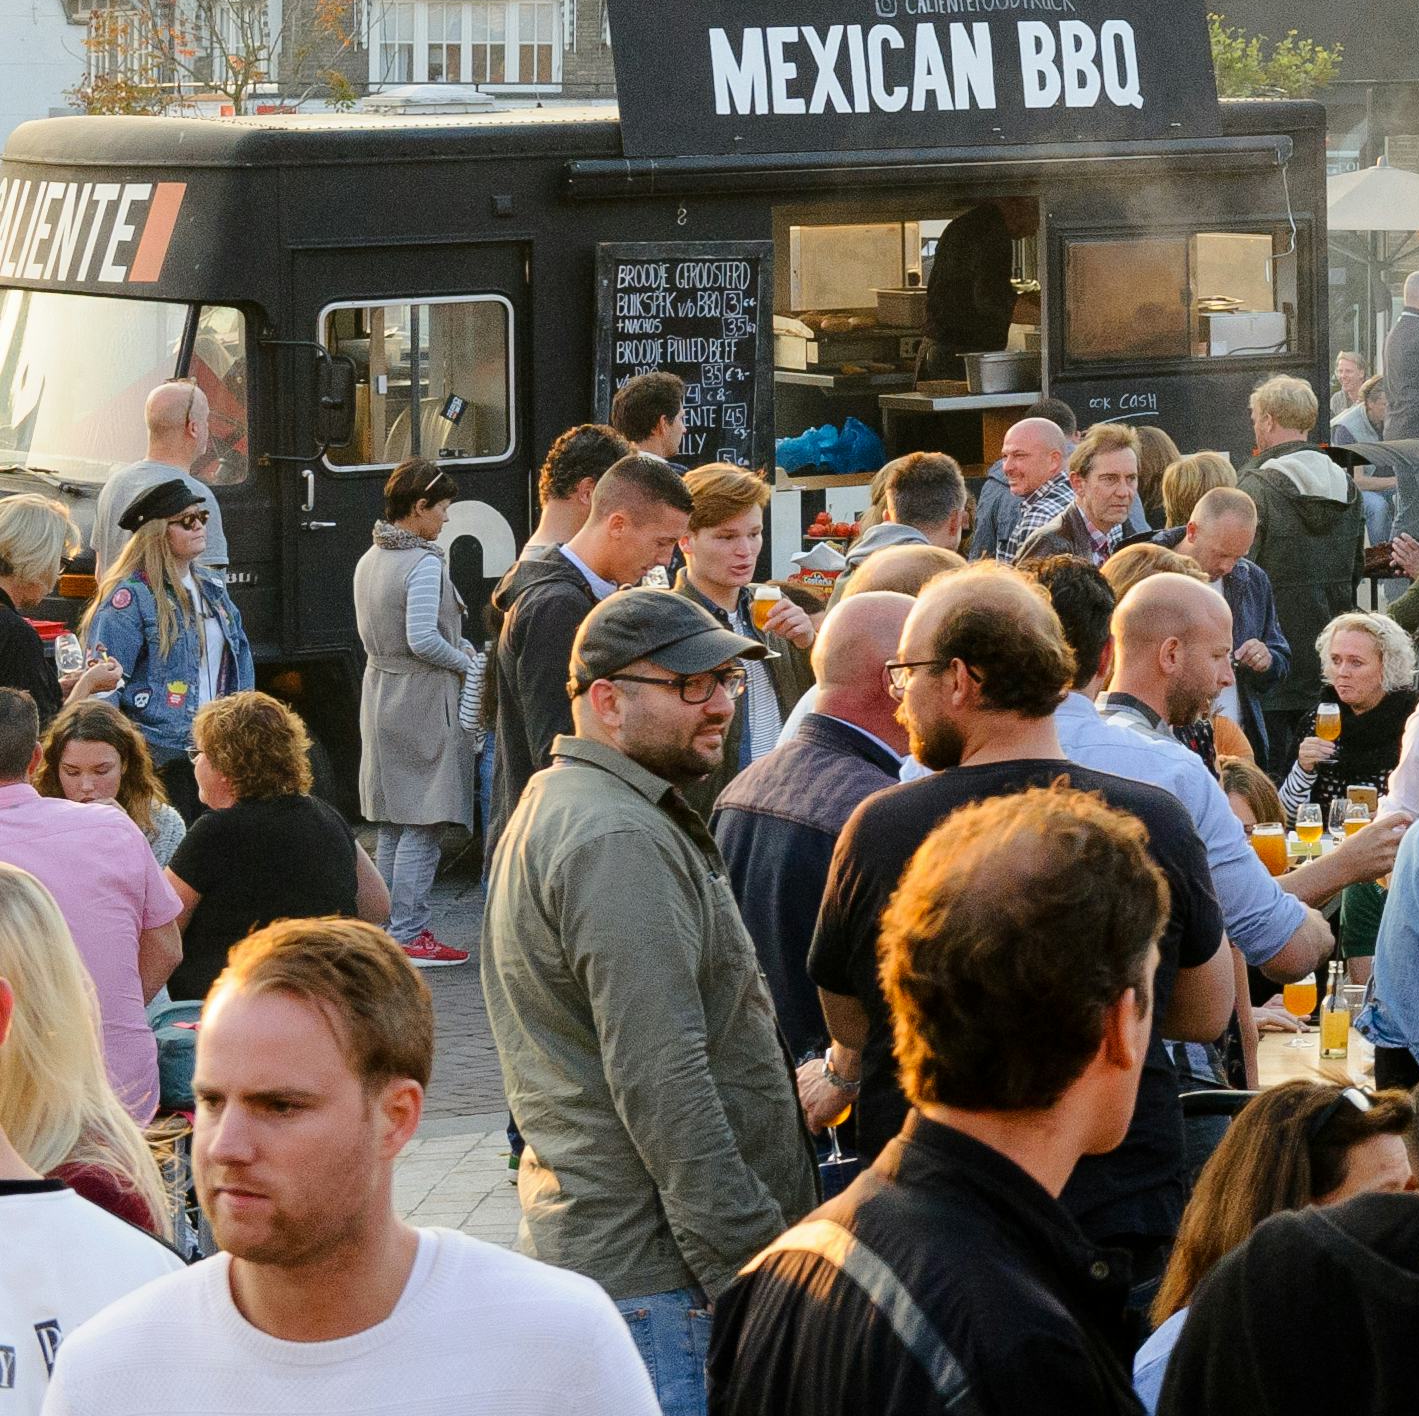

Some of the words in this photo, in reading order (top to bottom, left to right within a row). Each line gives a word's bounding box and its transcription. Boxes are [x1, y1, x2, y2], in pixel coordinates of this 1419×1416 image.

[709, 22, 996, 114] MEXICAN
[1017, 19, 1144, 110] BBQ
[0, 177, 152, 282] ALIENTE
[675, 261, 750, 290] GEROOSTERD
[697, 291, 721, 318] BBQ
[667, 334, 708, 363] PULLED
[709, 338, 738, 363] BEEF
[682, 406, 718, 427] ENTE
